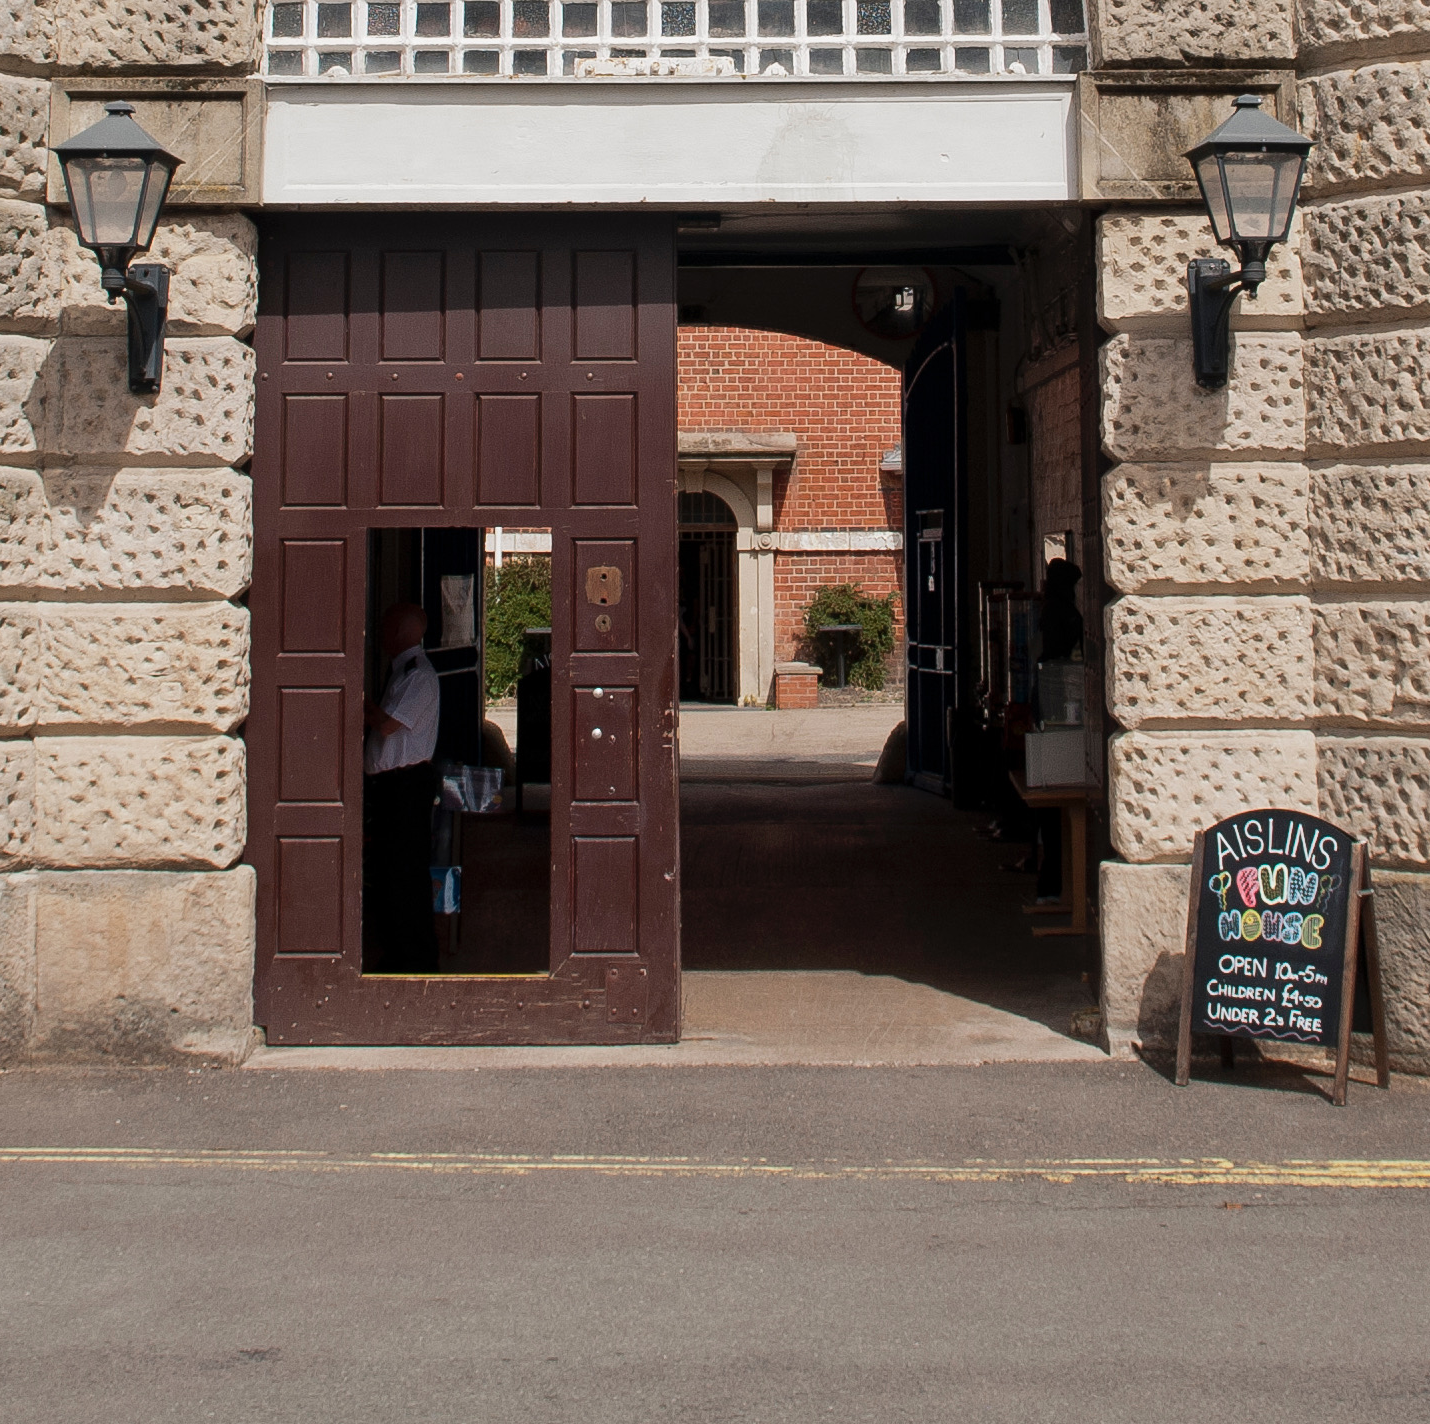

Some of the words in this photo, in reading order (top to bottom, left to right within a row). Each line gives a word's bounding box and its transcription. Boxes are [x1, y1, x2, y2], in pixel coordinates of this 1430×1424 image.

[1216, 818, 1338, 870] AISLINS
[1236, 863, 1319, 908] FUN
[1218, 909, 1324, 949] HOUSE
[1218, 954, 1268, 978] OPEN
[1206, 978, 1276, 1002] CHILDREN
[1207, 1002, 1260, 1025] UNDER
[1289, 1009, 1323, 1033] FREE
